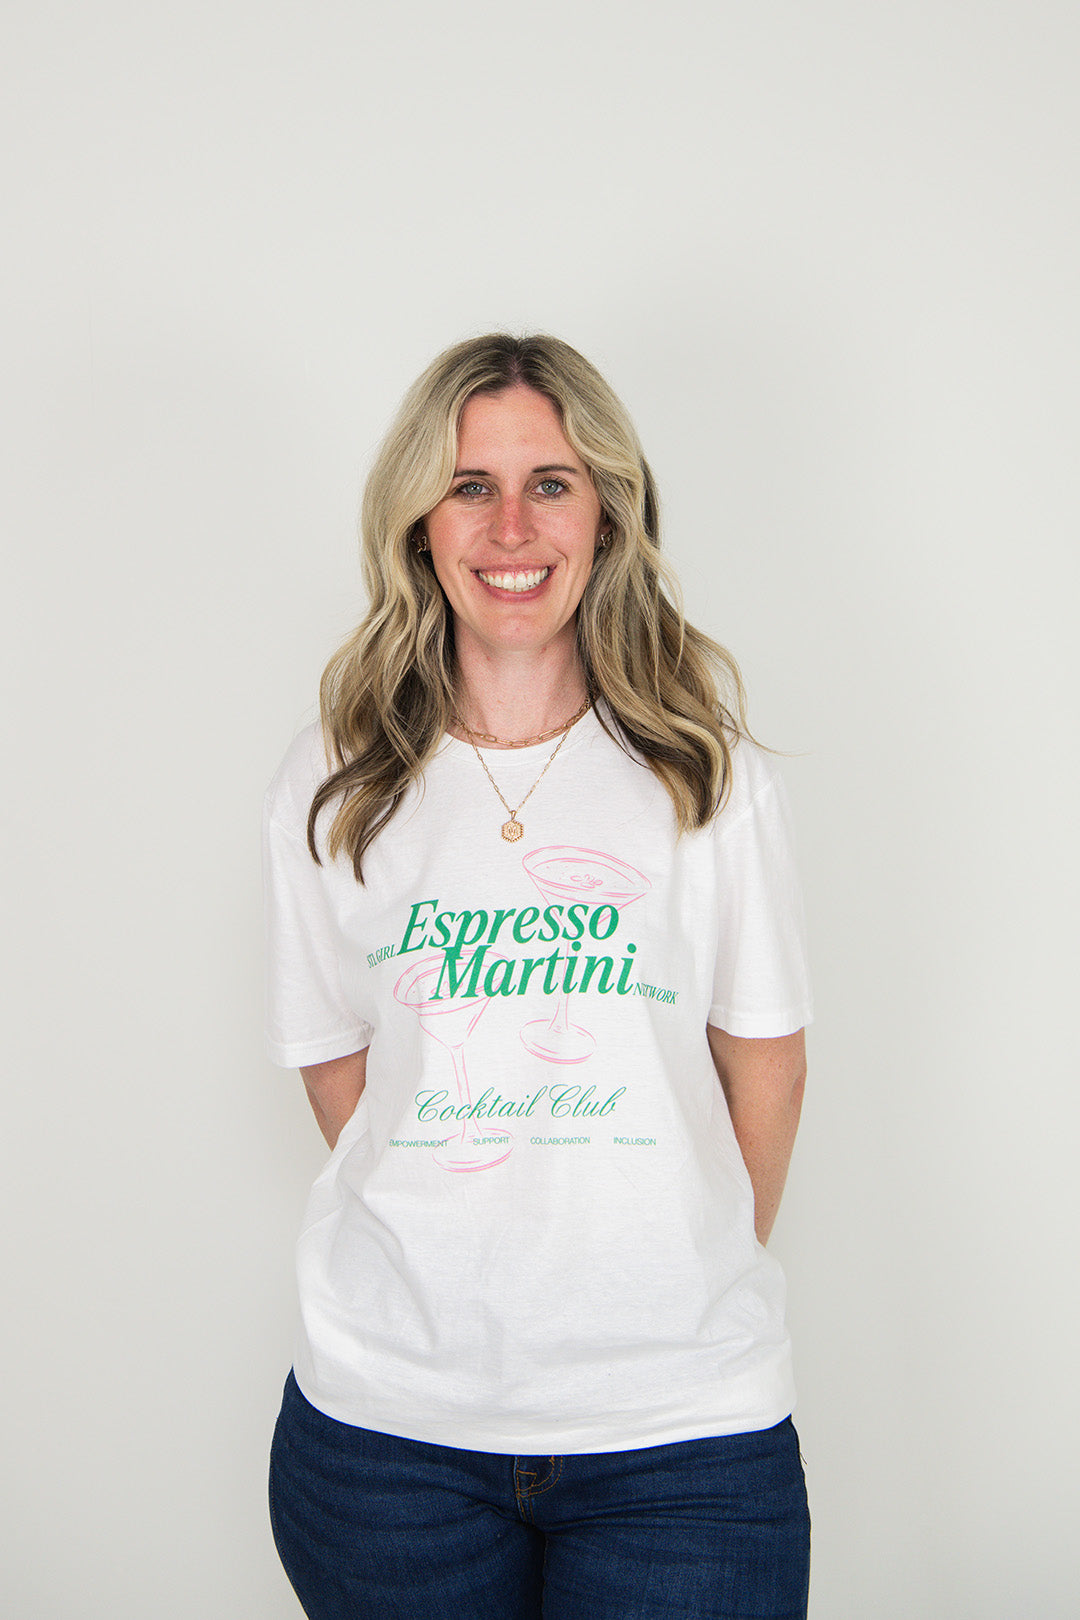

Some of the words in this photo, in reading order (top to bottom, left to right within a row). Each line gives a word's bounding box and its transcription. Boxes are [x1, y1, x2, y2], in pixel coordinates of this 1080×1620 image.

[396, 899, 619, 960] Espresso
[375, 944, 396, 964] GIRL
[428, 941, 637, 1001] Martini
[414, 1086, 549, 1123] Cocktail
[549, 1083, 628, 1119] Club
[389, 1138, 449, 1148] EMPOWERMENT
[472, 1136, 510, 1146] SUPPORT
[530, 1136, 591, 1145] COLLABORATION
[613, 1136, 656, 1146] INCLUSION
